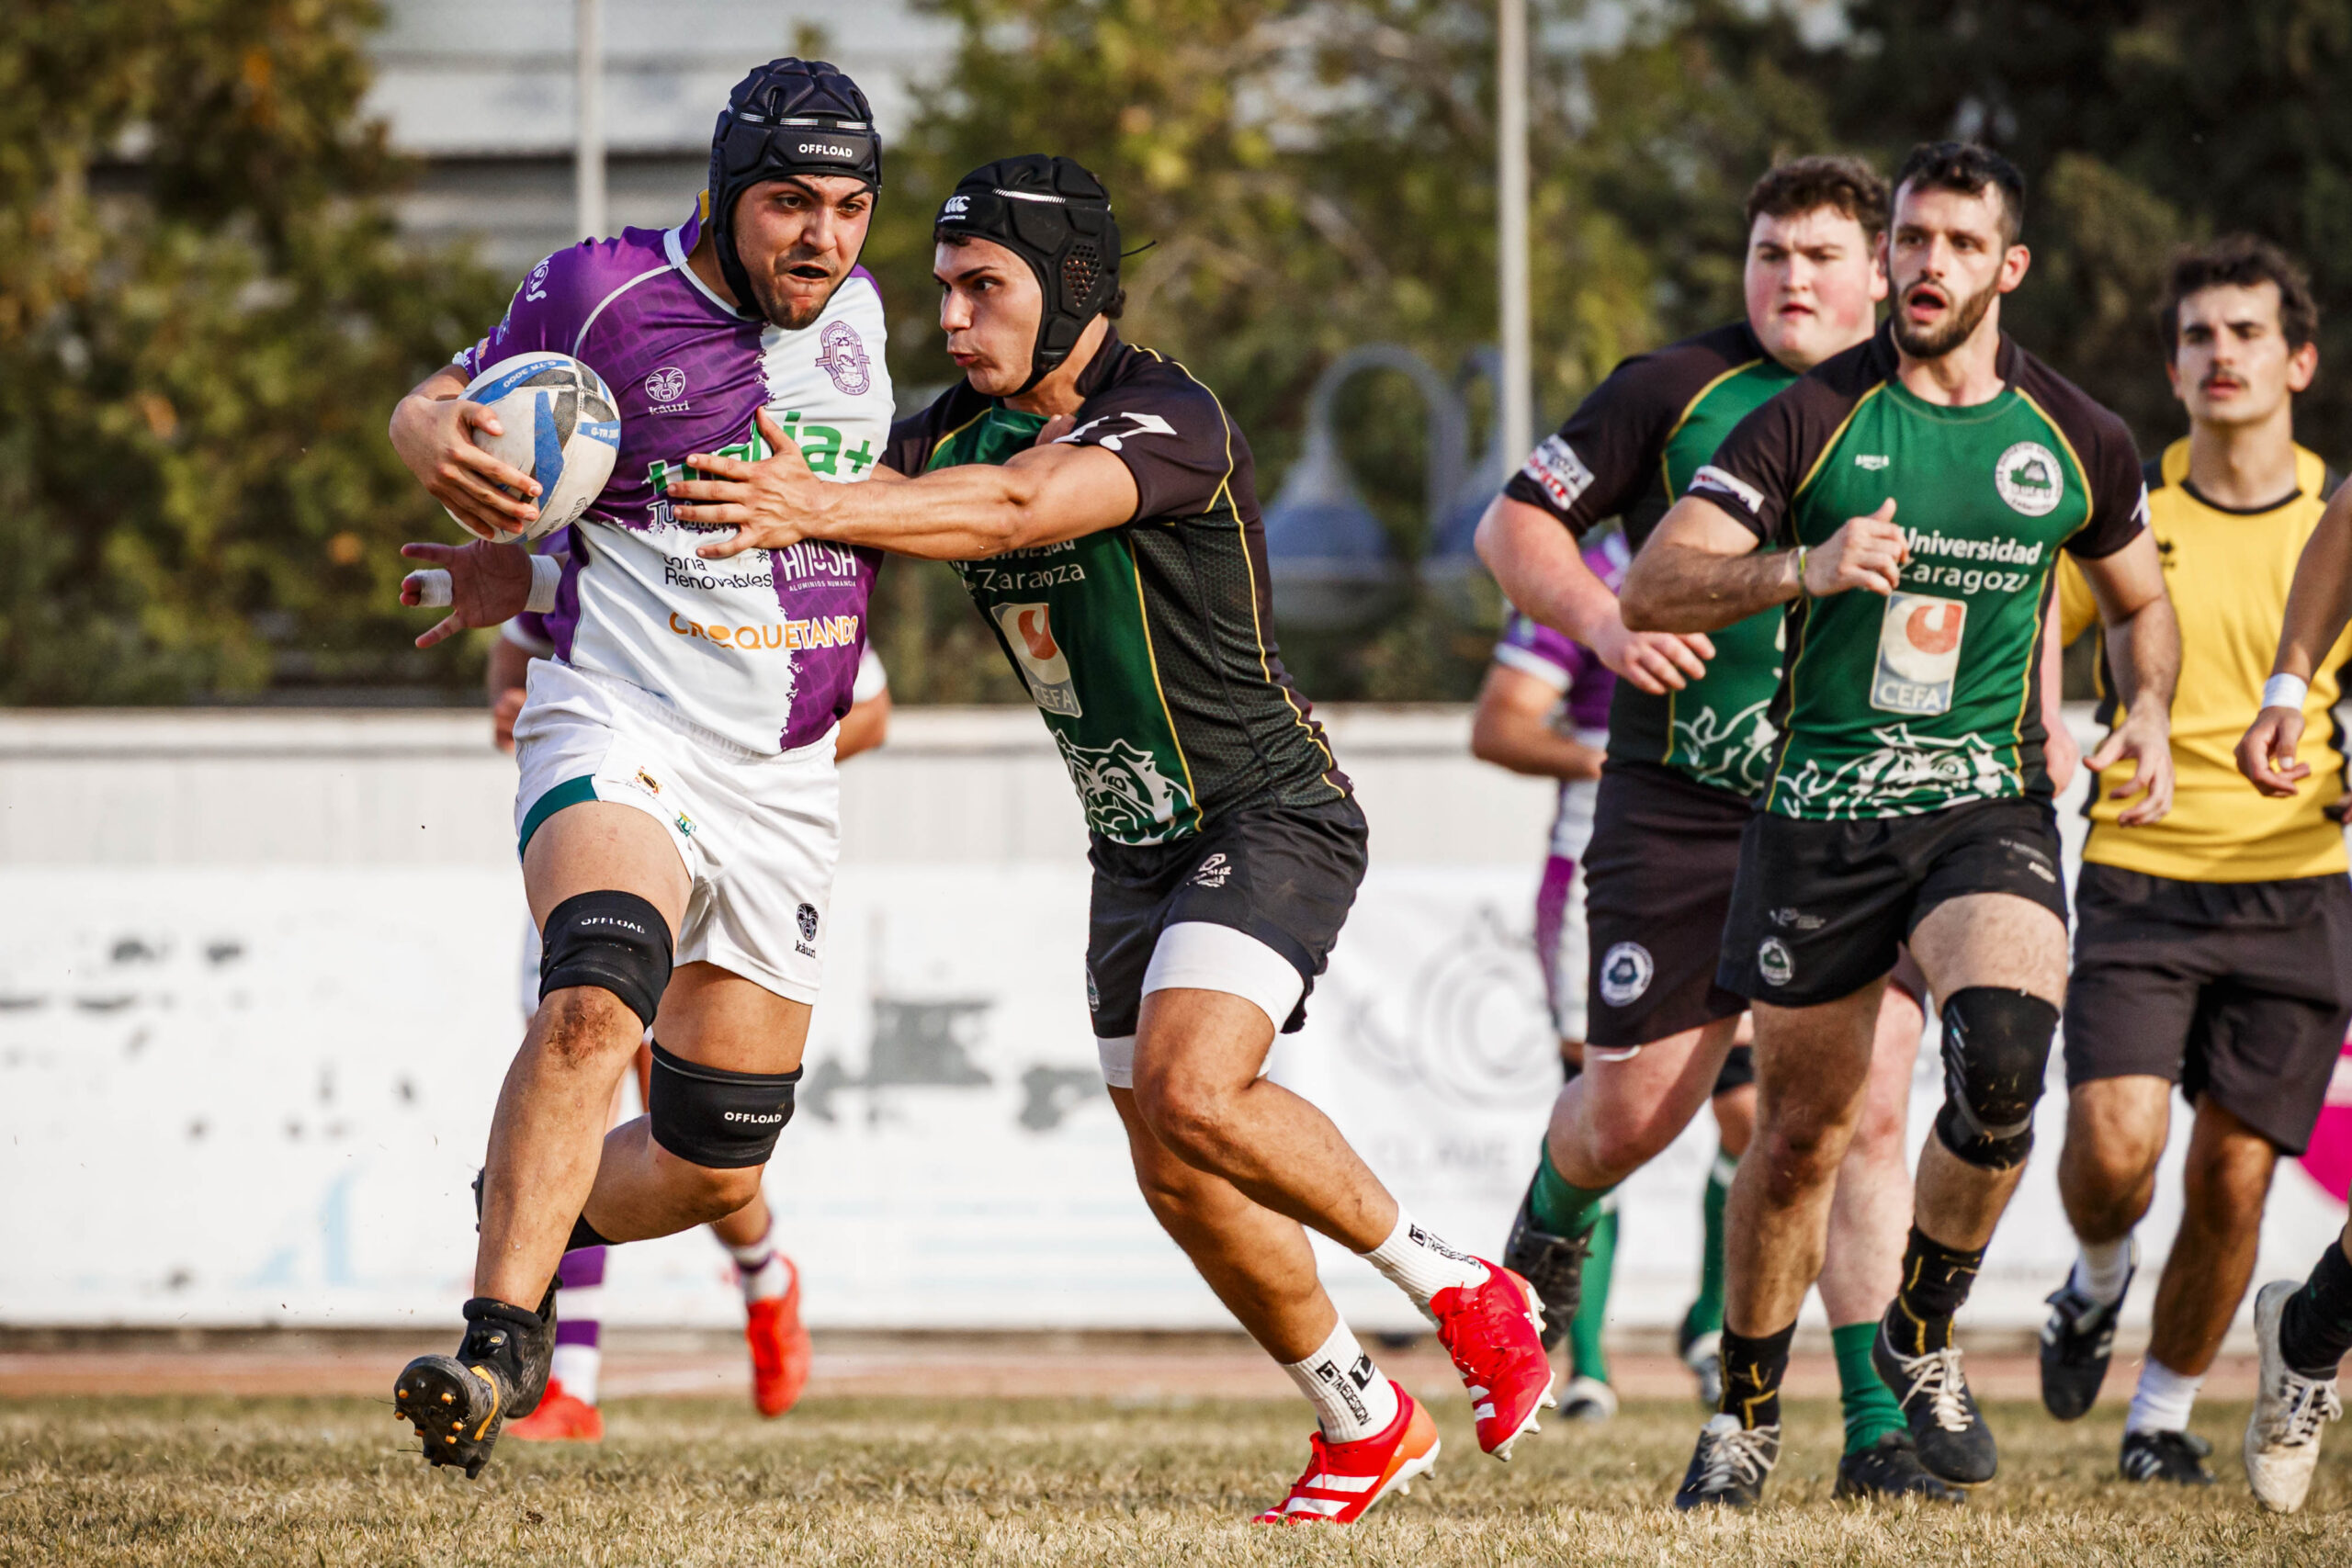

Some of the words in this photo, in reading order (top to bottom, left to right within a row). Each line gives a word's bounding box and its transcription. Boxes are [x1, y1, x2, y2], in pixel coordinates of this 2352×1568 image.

[798, 143, 854, 158] OFFLOAD
[835, 336, 851, 347] 25
[503, 367, 529, 389] 3000
[1898, 526, 2044, 566] Universidad
[664, 566, 773, 590] Renovables
[976, 562, 1087, 592] Zaraoza
[1032, 683, 1076, 711] CEFA
[1878, 681, 1943, 710] CEFA
[581, 918, 645, 934] OFFLOAD
[724, 1111, 783, 1123] OFFLOAD
